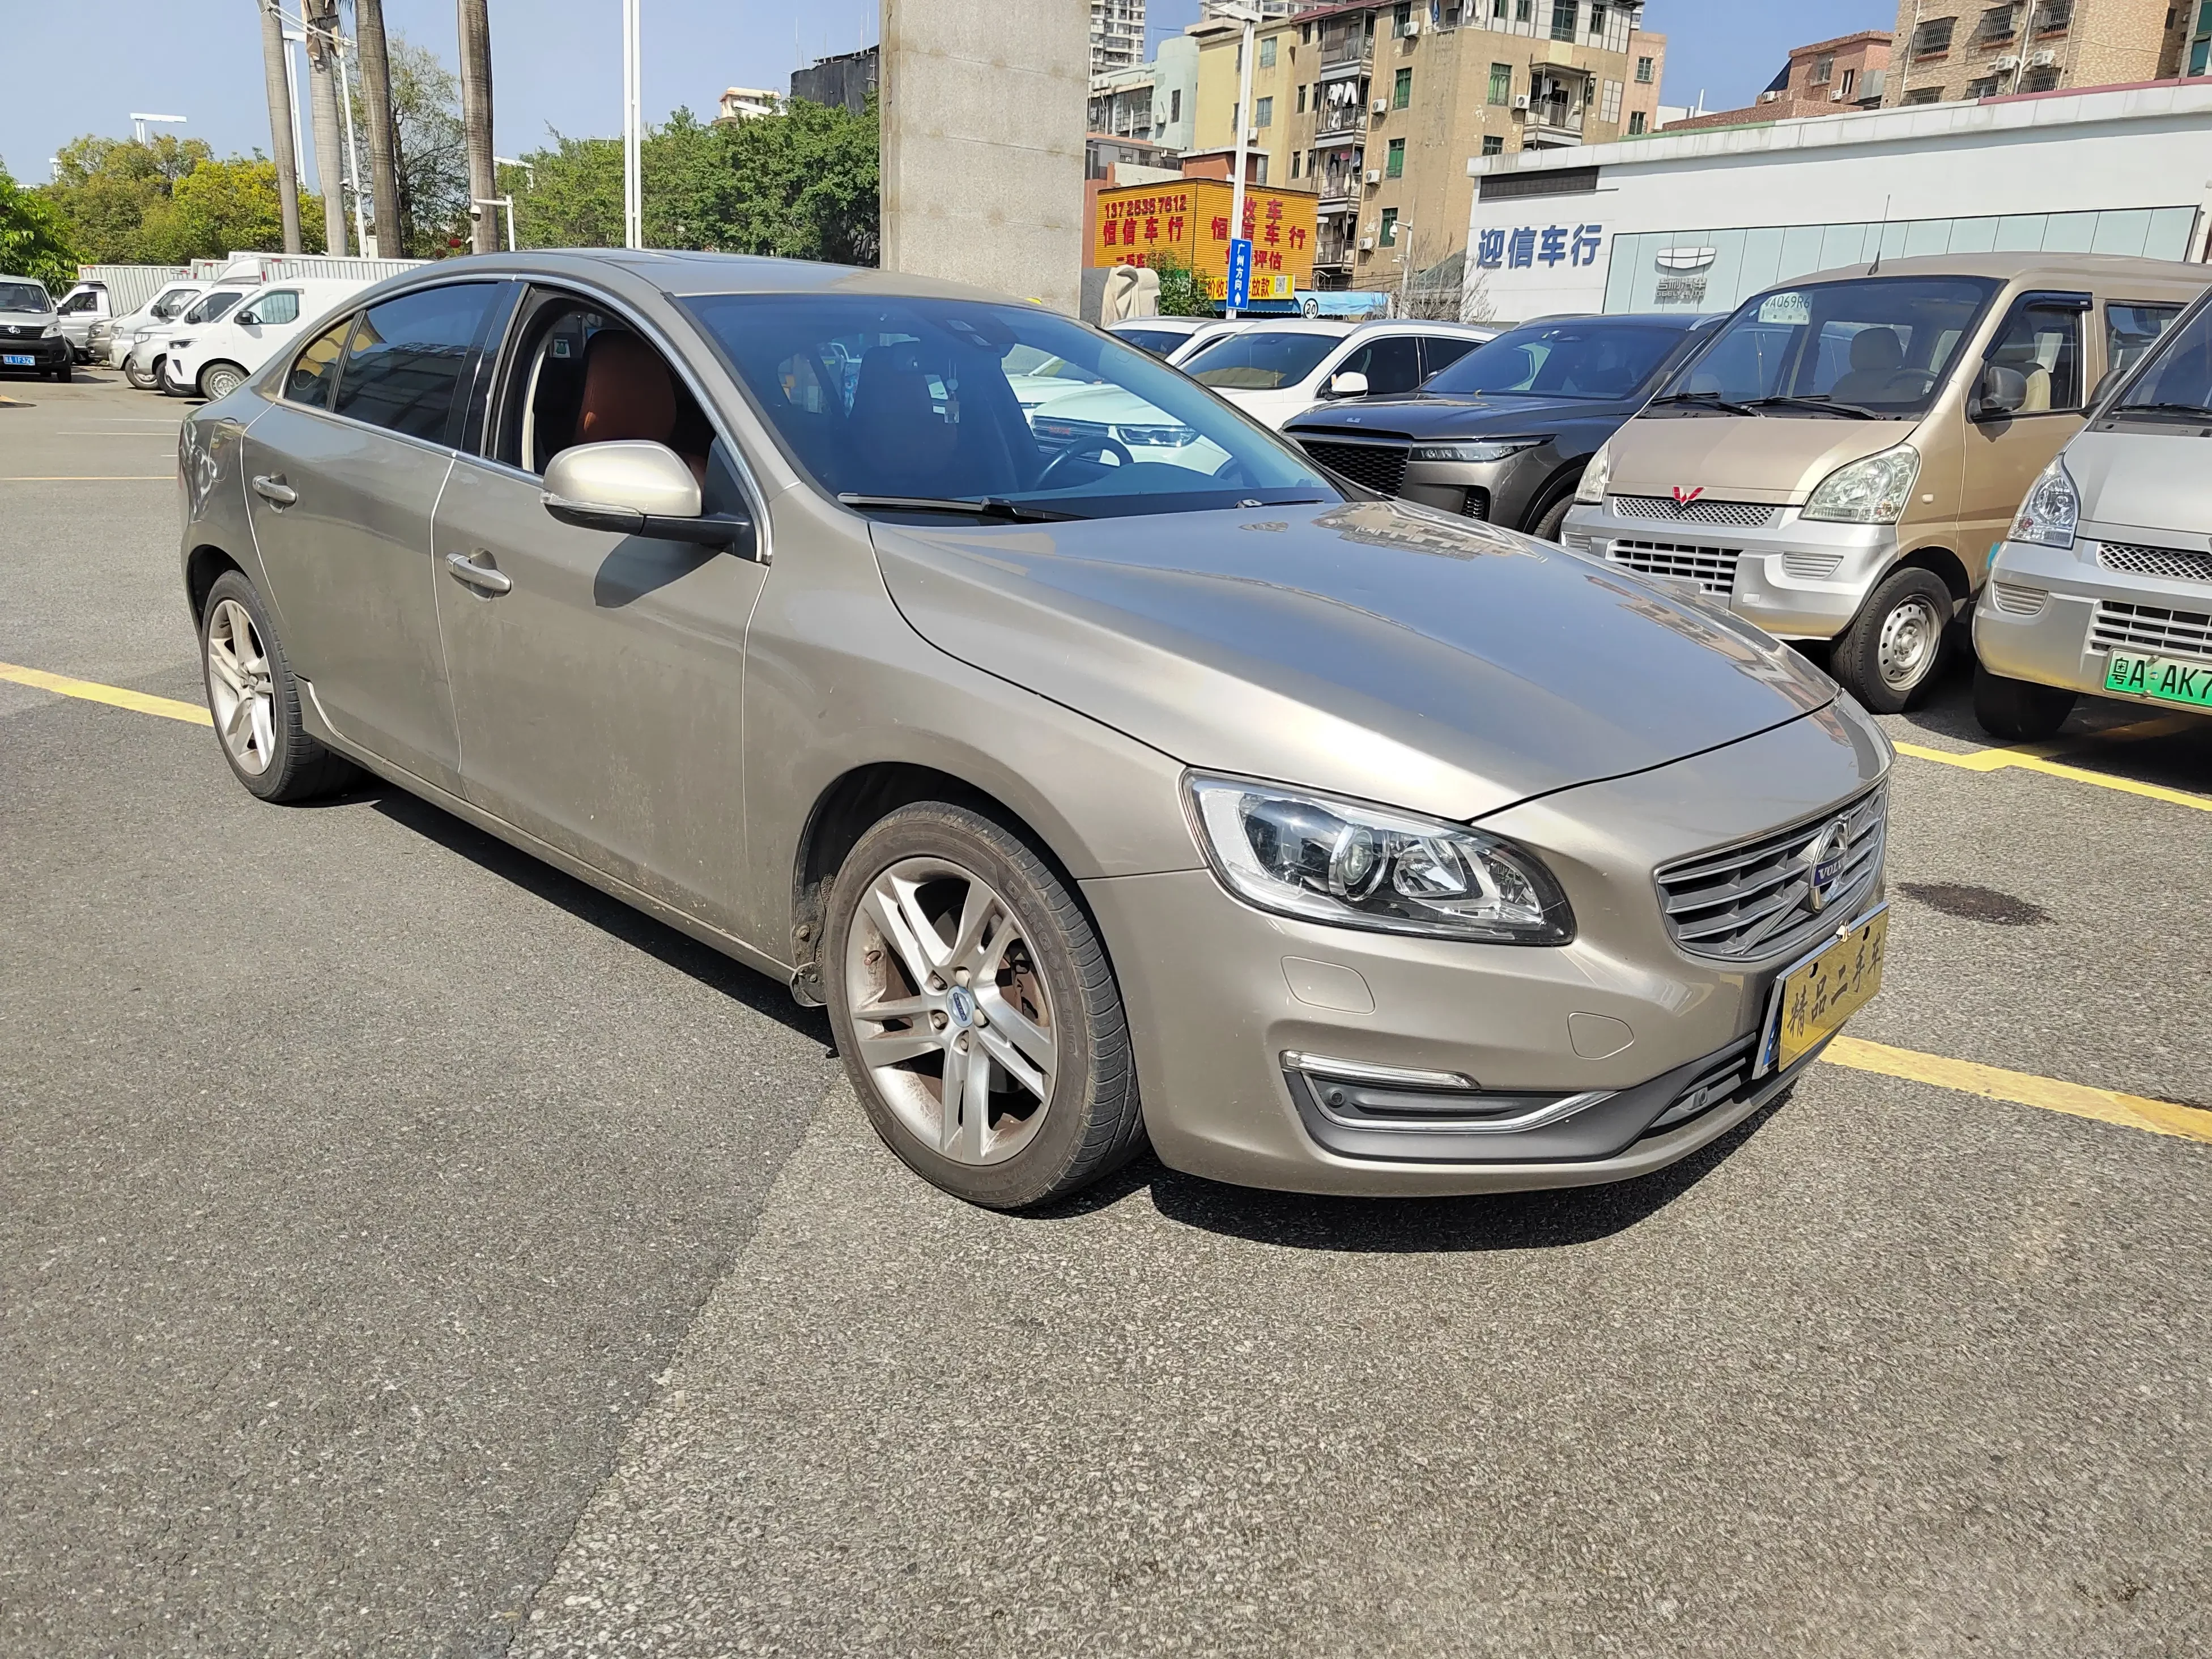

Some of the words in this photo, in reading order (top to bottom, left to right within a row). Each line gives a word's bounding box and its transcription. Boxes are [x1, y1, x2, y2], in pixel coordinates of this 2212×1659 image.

[1103, 216, 1184, 248] 恒信车行
[1477, 223, 1602, 270] 迎信车行
[1225, 244, 1283, 271] 评估
[1235, 243, 1245, 291] 广州方向
[1657, 277, 1708, 290] 吉利汽车
[1306, 303, 1316, 315] 20
[1786, 932, 1881, 1039] 精品二手车
